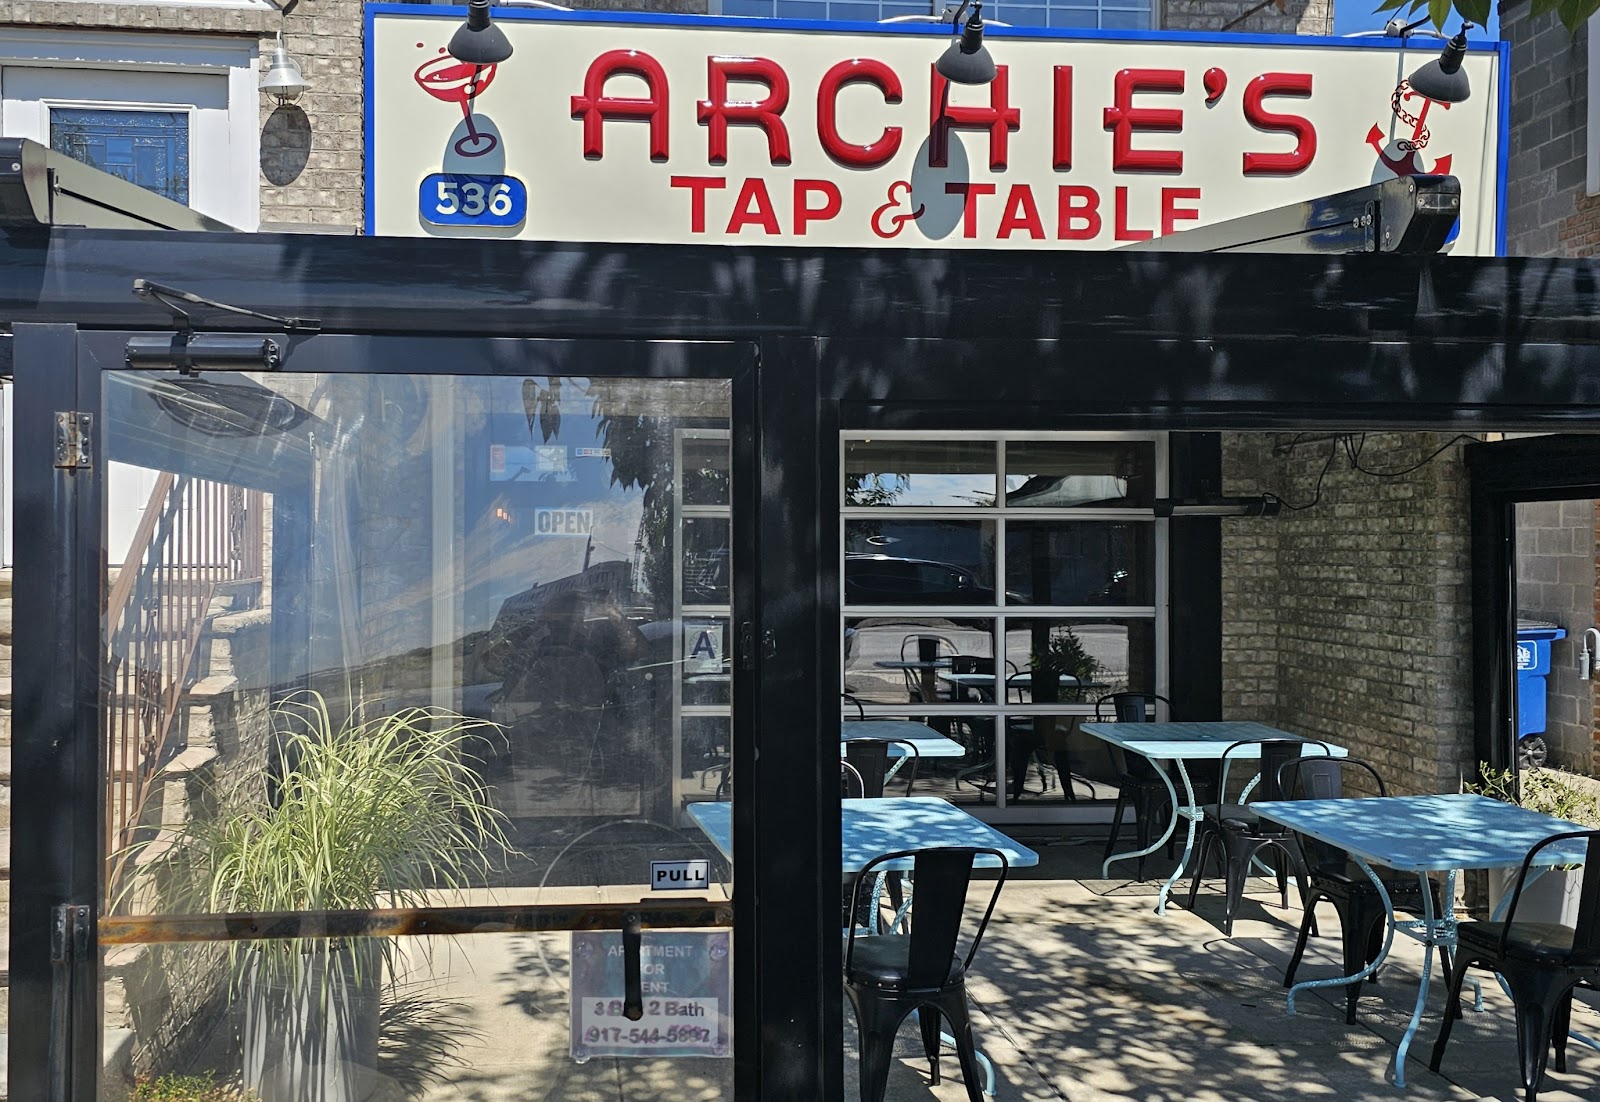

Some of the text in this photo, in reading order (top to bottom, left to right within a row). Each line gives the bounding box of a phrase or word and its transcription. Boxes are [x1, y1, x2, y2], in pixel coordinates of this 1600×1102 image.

[571, 49, 1318, 177] ARCHIE'S
[436, 182, 512, 216] 536
[671, 176, 1201, 241] TAP & TABLE
[538, 511, 591, 534] OPEN
[690, 631, 715, 660] A
[657, 870, 705, 882] PULL
[607, 945, 694, 958] APRTMENT
[641, 963, 665, 975] OR
[641, 982, 670, 993] ENT
[594, 1001, 605, 1016] 3
[648, 1000, 661, 1016] 2
[664, 1001, 705, 1017] Bath
